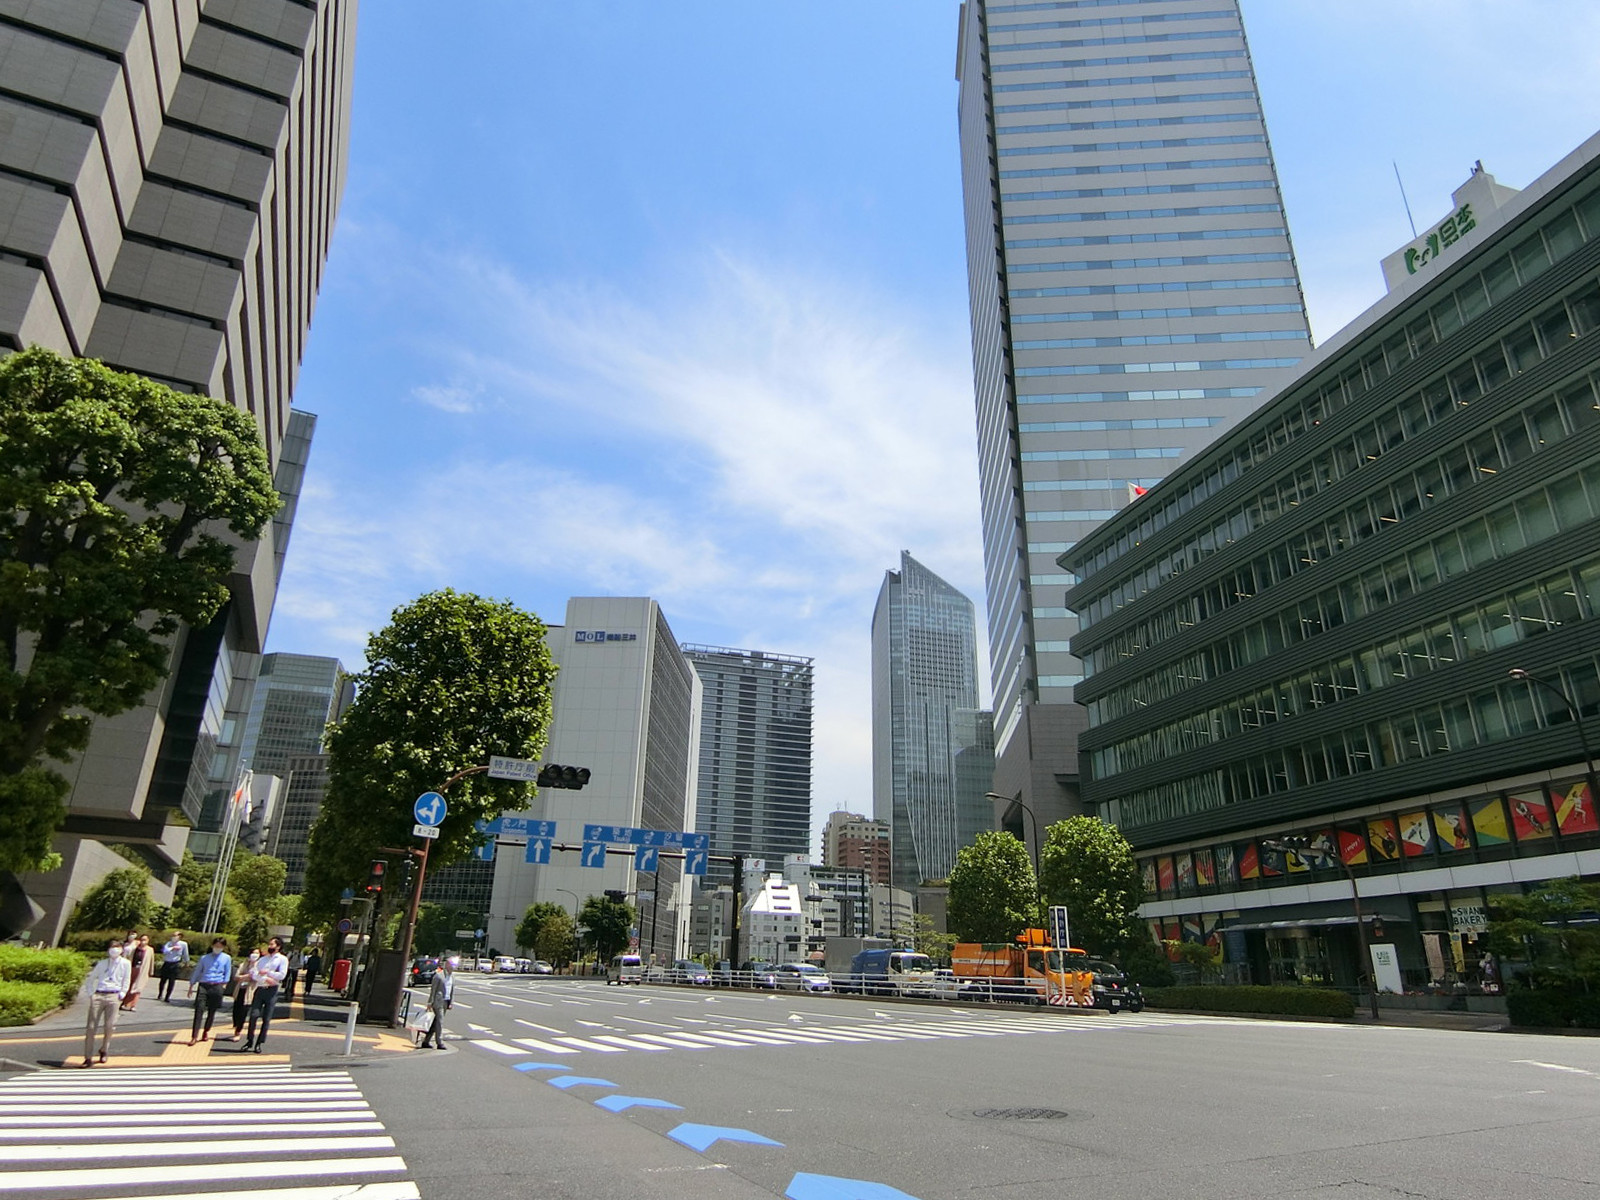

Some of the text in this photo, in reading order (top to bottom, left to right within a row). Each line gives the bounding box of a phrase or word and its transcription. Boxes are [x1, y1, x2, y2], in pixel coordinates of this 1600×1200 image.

[575, 630, 606, 643] MOL
[494, 759, 536, 773] 特許庁前
[502, 818, 527, 829] 虎ノ門
[417, 827, 437, 836] 8-20
[1457, 906, 1480, 916] SWAN
[1453, 915, 1487, 926] BAKERY
